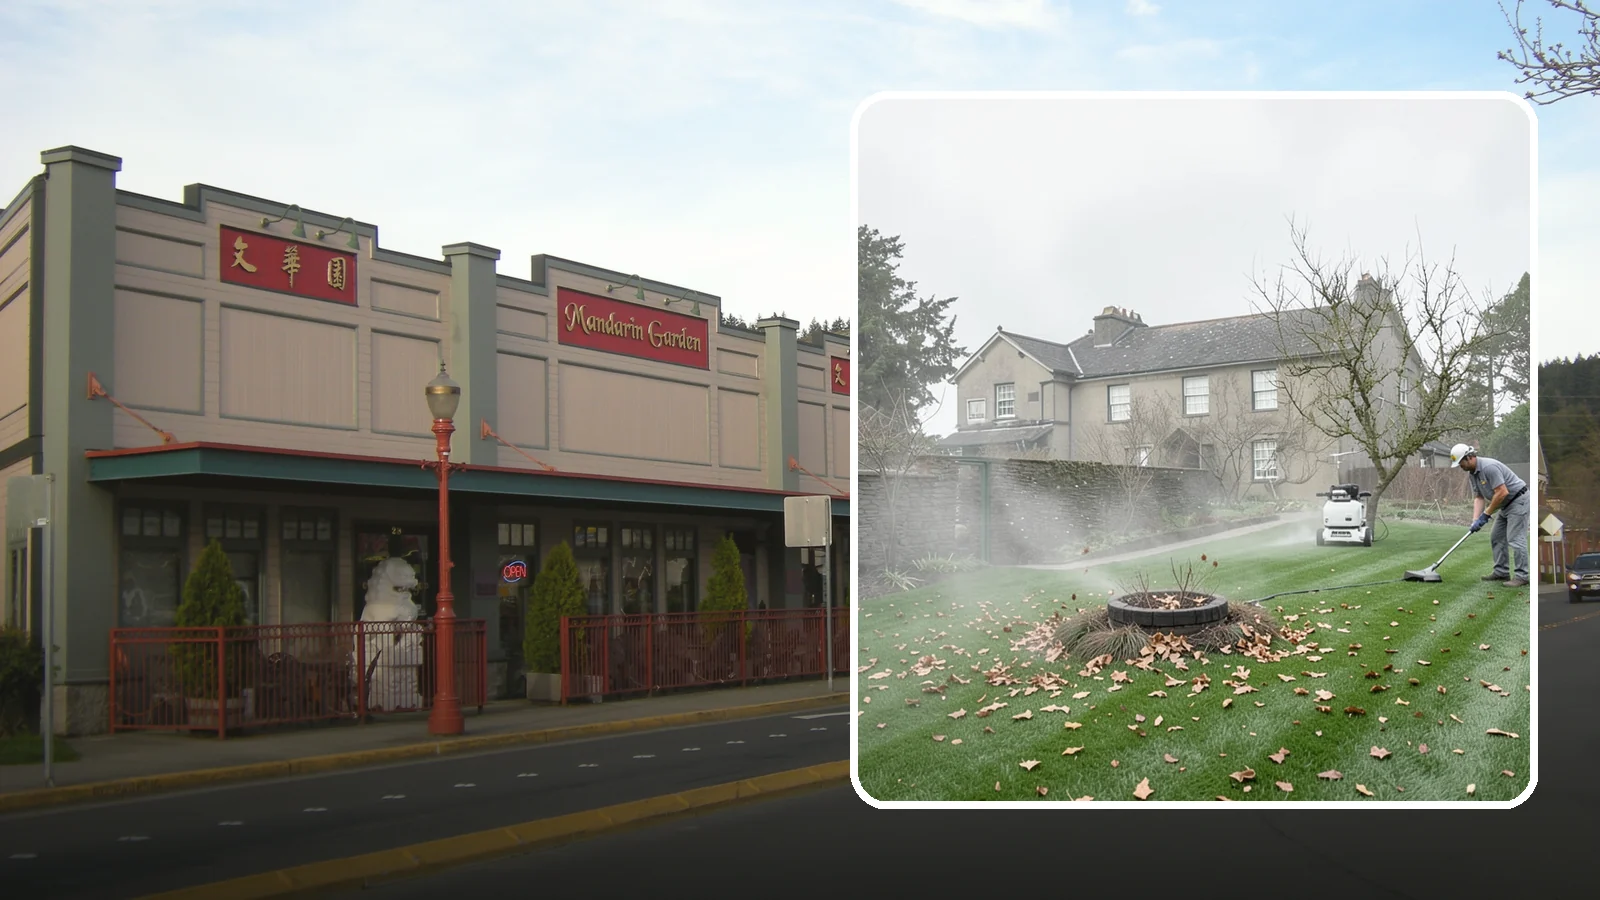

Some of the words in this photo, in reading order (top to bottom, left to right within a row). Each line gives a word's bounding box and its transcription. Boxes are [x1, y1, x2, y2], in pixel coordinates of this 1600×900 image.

[231, 235, 346, 291] 文華園
[564, 302, 644, 341] Mandarin
[648, 320, 701, 352] Garden
[503, 566, 527, 578] OPEN
